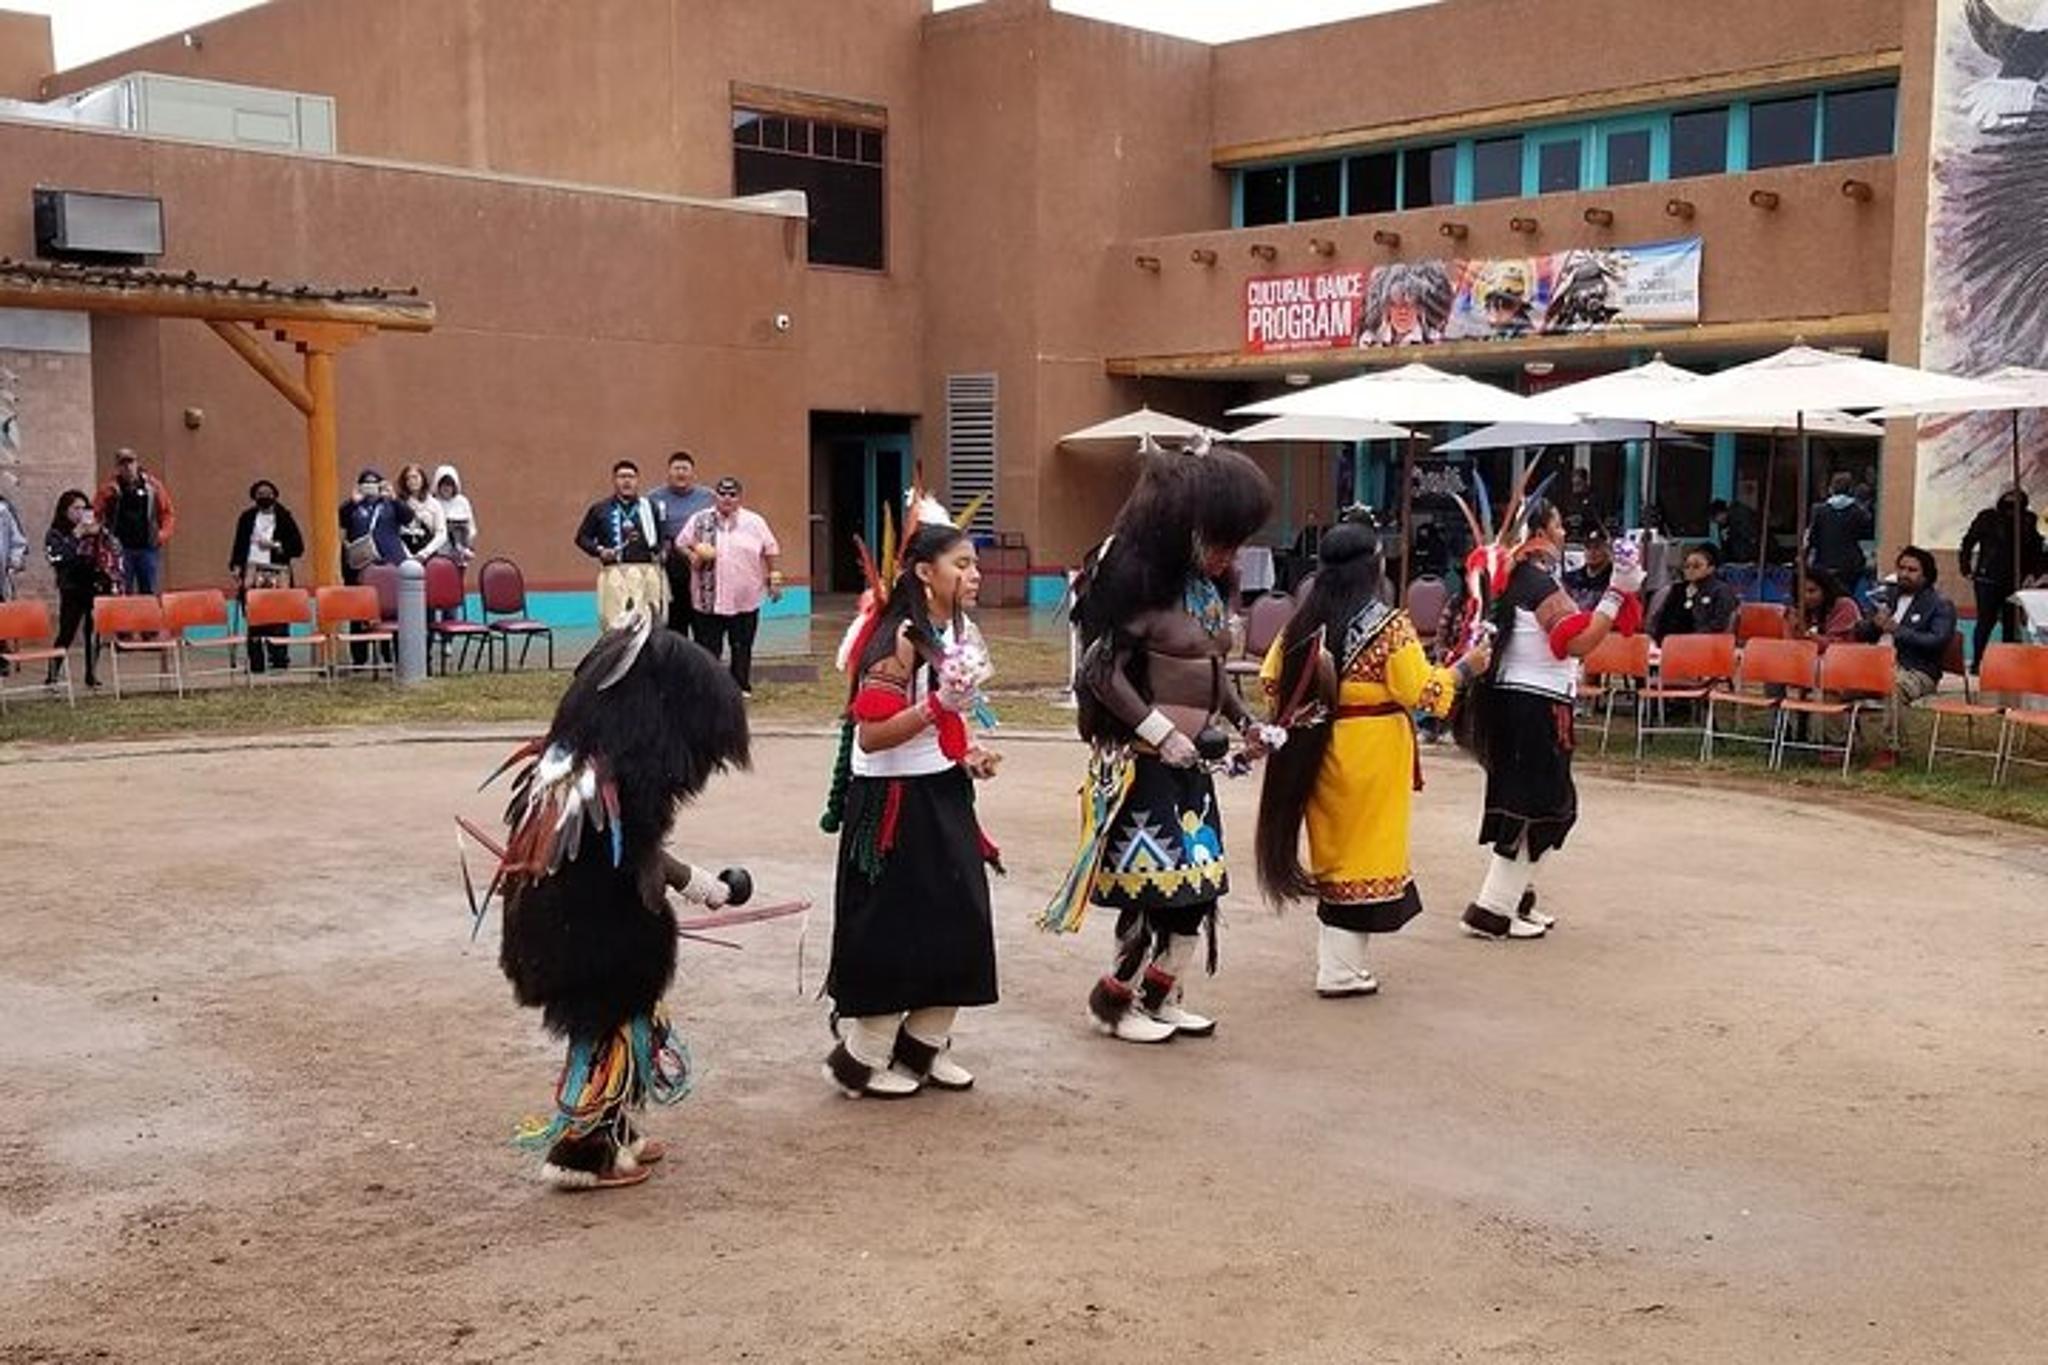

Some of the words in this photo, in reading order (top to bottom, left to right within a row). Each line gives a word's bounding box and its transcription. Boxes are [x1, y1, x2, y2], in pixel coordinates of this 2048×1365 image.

[1248, 276, 1312, 305] CULTURAL
[1316, 272, 1362, 300] DANCE
[1247, 301, 1352, 342] PROGRAM
